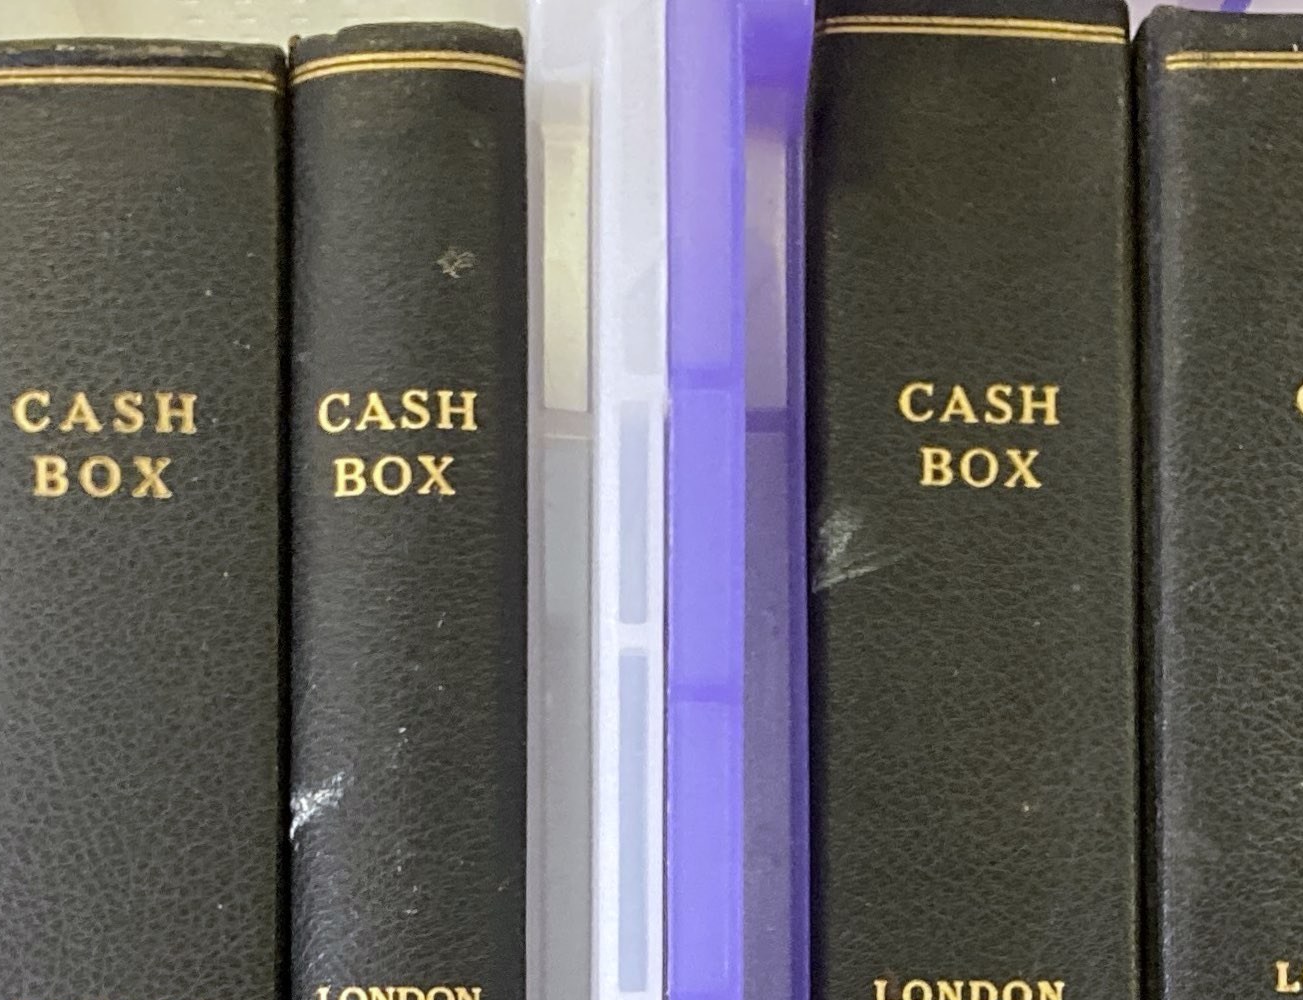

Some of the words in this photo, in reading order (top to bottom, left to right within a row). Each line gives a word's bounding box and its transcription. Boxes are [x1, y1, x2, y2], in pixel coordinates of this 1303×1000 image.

[9, 391, 198, 436] CASH
[315, 388, 477, 436] CASH
[898, 382, 1060, 425] CASH
[30, 455, 172, 499] BOX
[334, 452, 456, 498] BOX
[920, 447, 1042, 489] BOX
